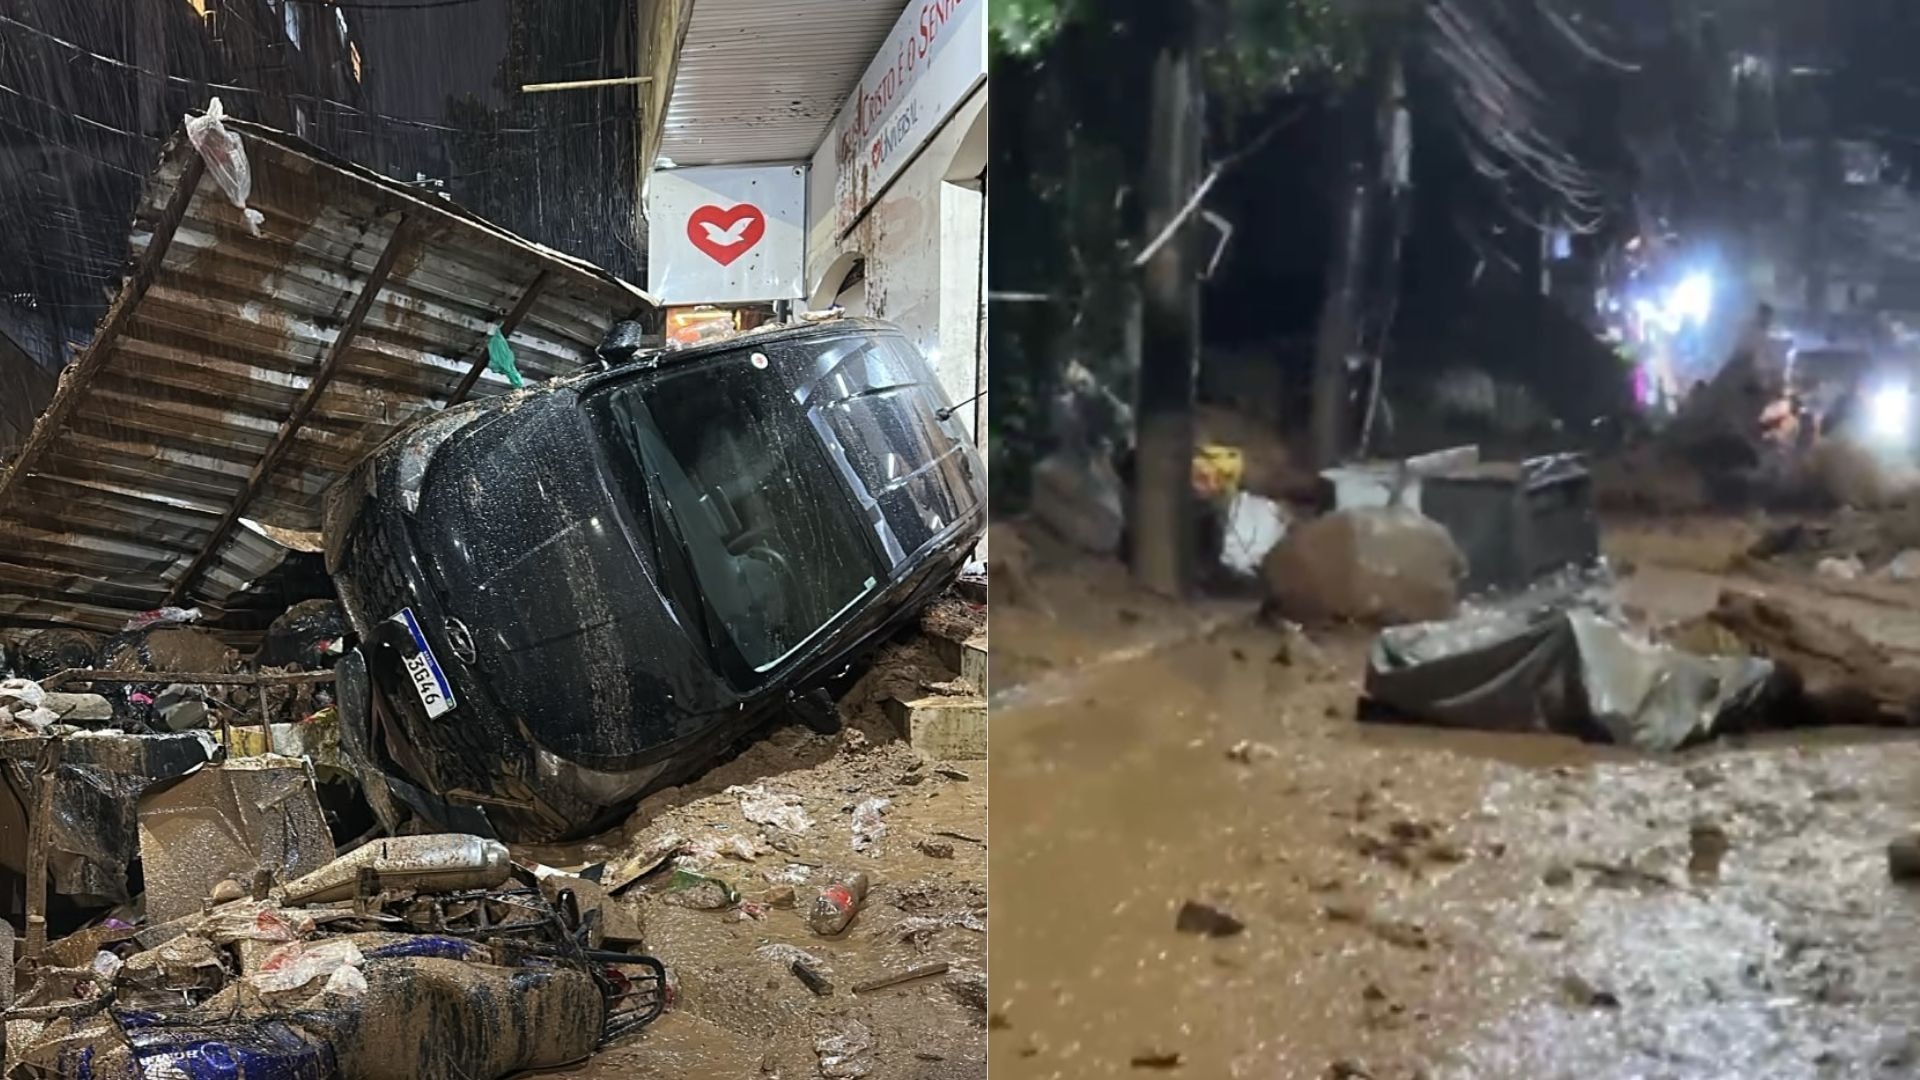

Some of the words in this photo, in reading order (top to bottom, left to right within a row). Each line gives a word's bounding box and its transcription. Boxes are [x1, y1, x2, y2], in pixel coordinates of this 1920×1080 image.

[862, 67, 895, 136] CRISTO
[907, 36, 916, 71] O
[407, 657, 441, 706] 3G46
